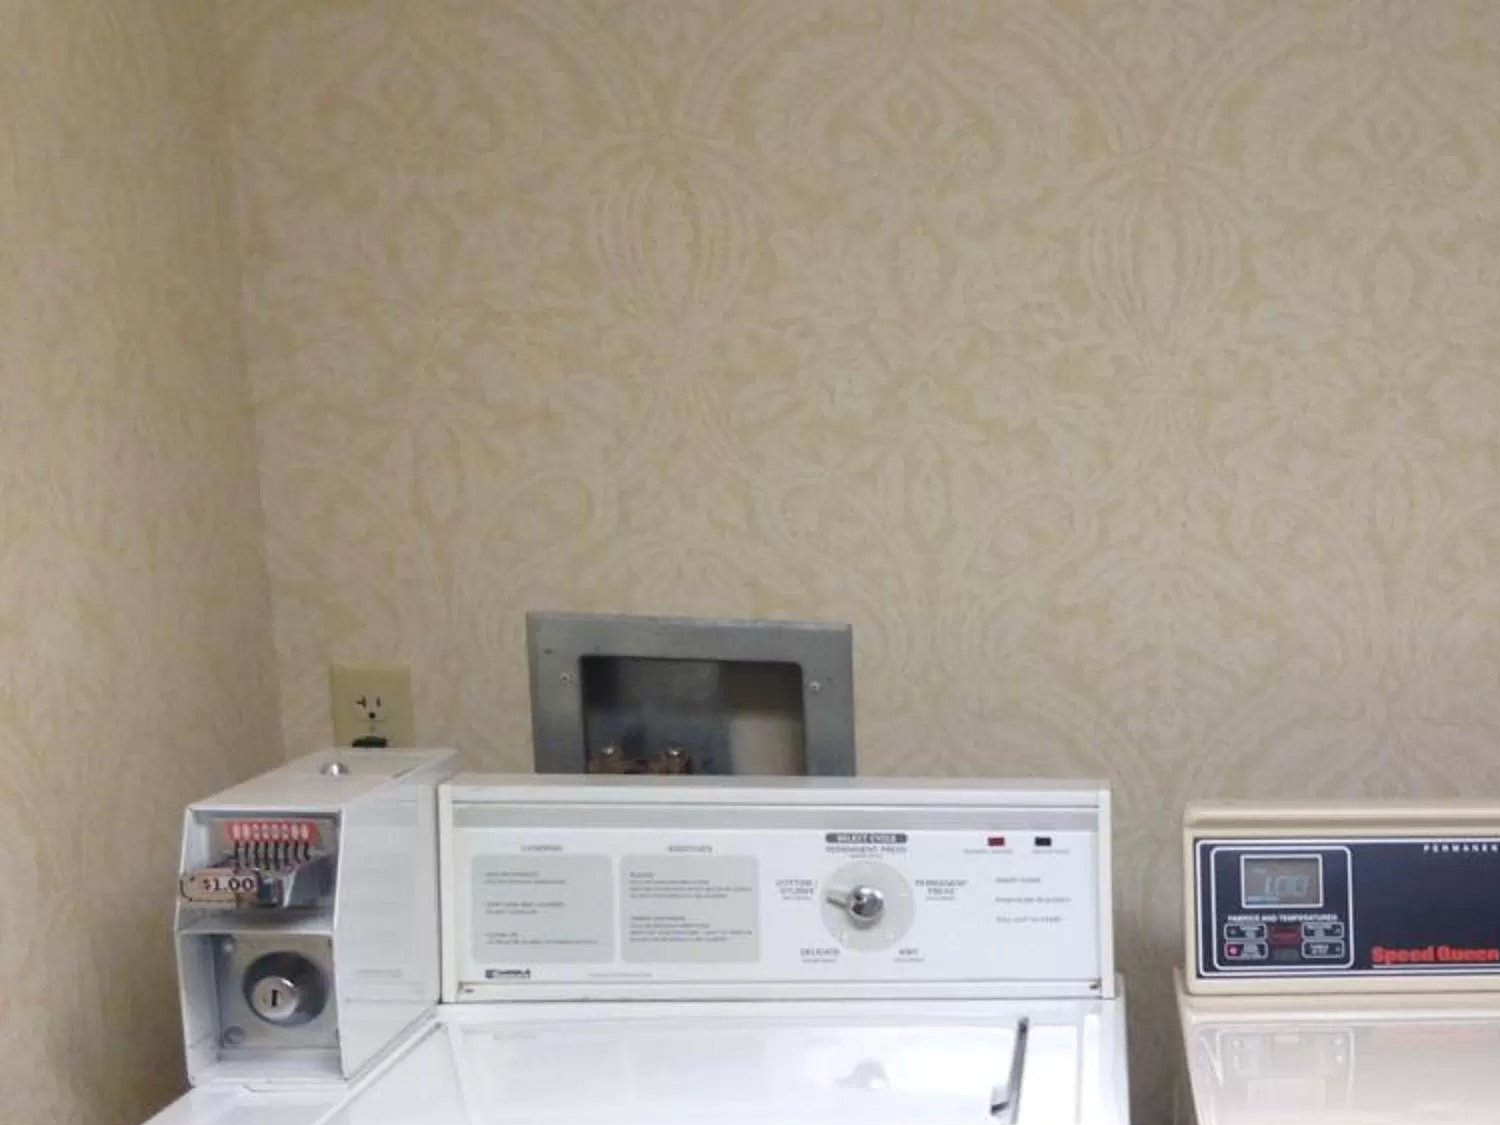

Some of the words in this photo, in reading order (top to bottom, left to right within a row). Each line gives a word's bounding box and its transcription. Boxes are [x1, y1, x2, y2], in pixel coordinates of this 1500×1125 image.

[202, 877, 255, 893] $1.00
[1371, 945, 1434, 965] Speed
[1436, 944, 1500, 962] Queen
